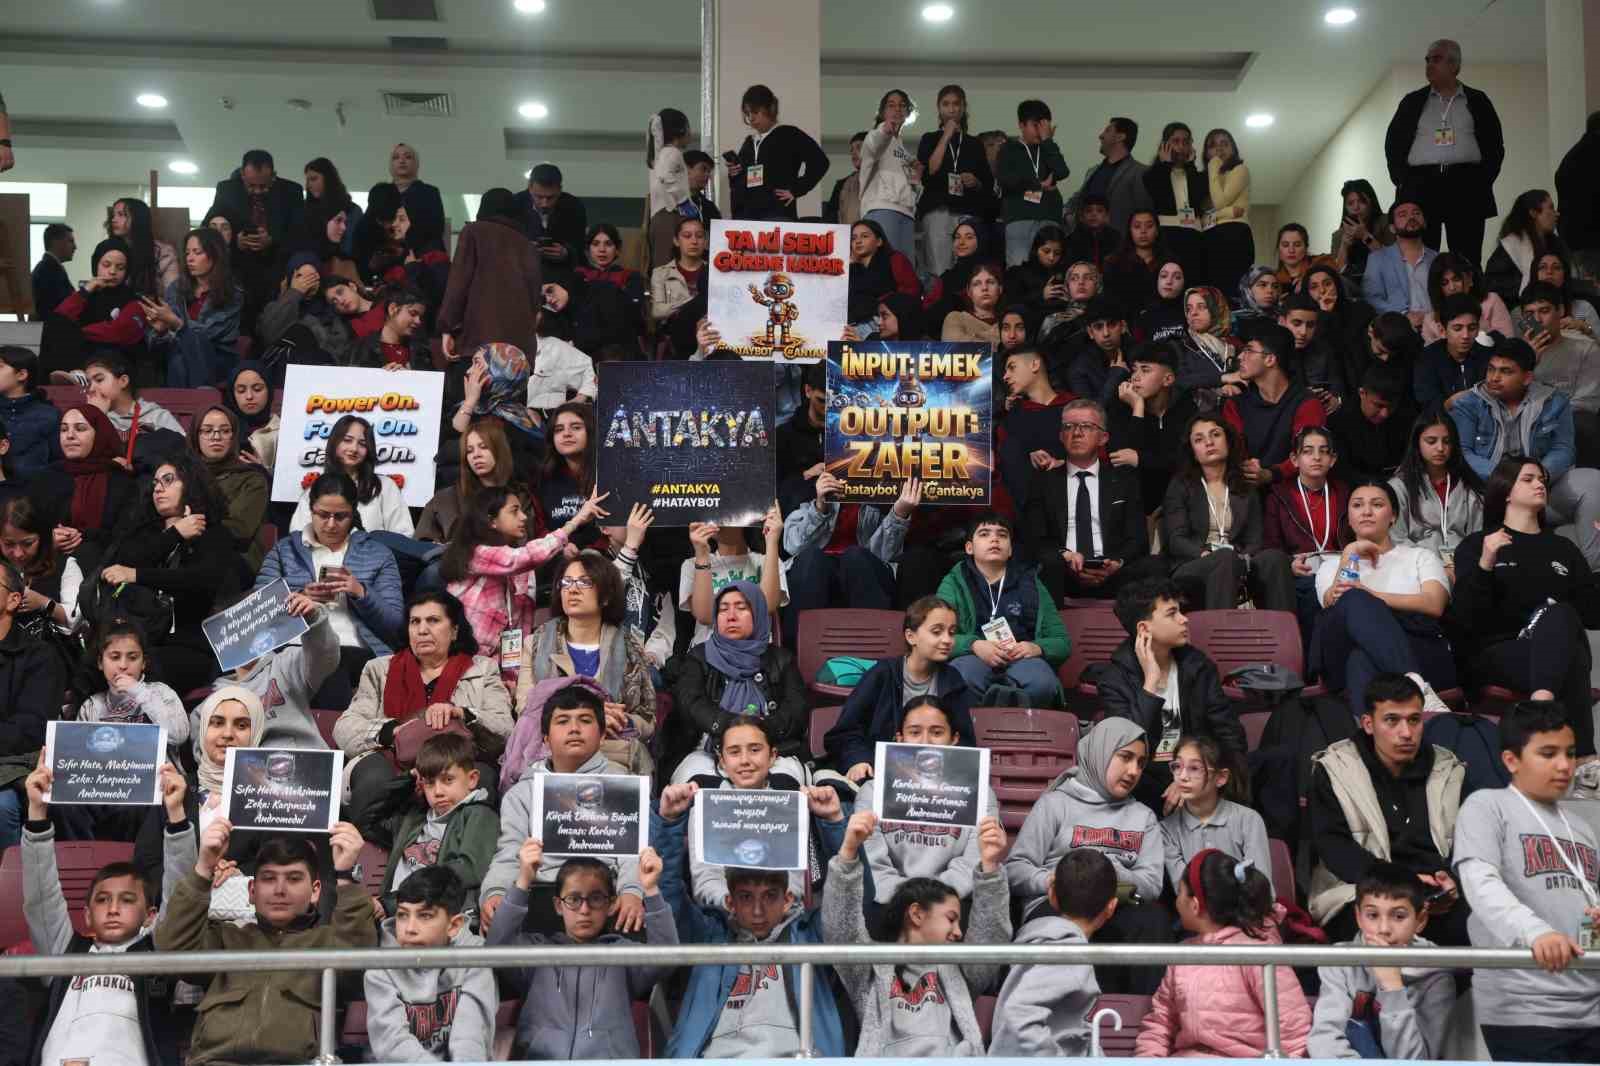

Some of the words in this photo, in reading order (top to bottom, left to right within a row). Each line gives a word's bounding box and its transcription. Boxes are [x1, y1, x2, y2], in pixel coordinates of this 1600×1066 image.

[713, 249, 784, 273] GÖRENE
[786, 254, 845, 275] KADAR
[918, 353, 984, 379] EMEK
[306, 395, 379, 414] Power
[379, 392, 420, 411] On.
[604, 403, 769, 448] ANTAKYA
[838, 407, 980, 438] OUTPUT:
[847, 441, 970, 480] ZAFER
[651, 483, 721, 495] #ANTAKYA
[652, 497, 721, 508] #HATAYBOT
[105, 760, 155, 771] Maksimum
